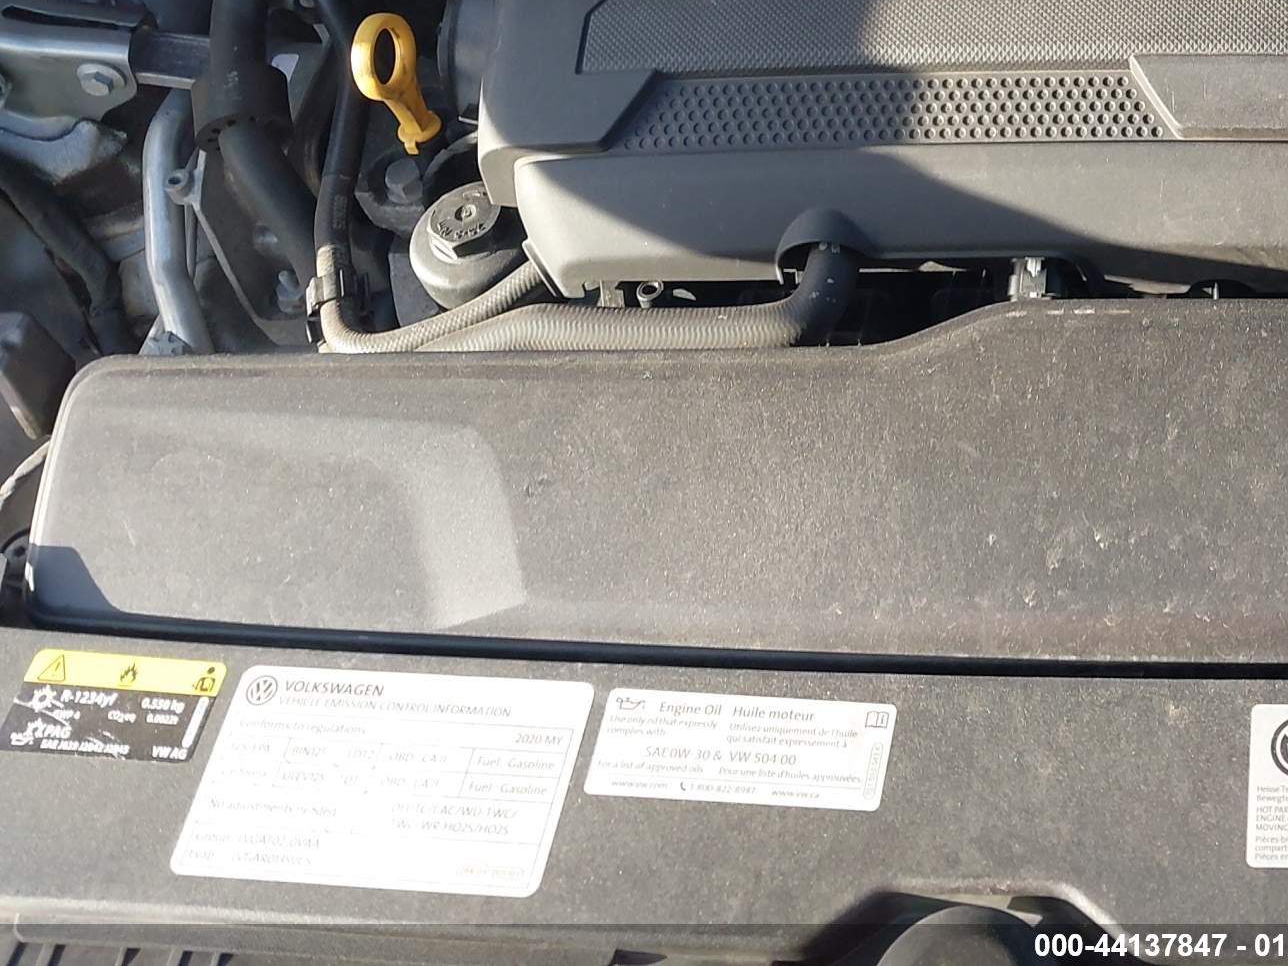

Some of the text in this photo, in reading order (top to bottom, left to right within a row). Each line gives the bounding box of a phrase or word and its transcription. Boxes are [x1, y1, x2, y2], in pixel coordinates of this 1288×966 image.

[285, 680, 384, 696] VOLKSWAGEN
[278, 696, 512, 717] VEHICLE EMISSION CONTROL INFORMATION
[659, 702, 814, 721] Engine Oil Huile moteur
[644, 746, 667, 758] SAE
[712, 750, 722, 760] &
[728, 751, 752, 763] VW
[754, 752, 778, 765] 504
[780, 754, 798, 766] 00
